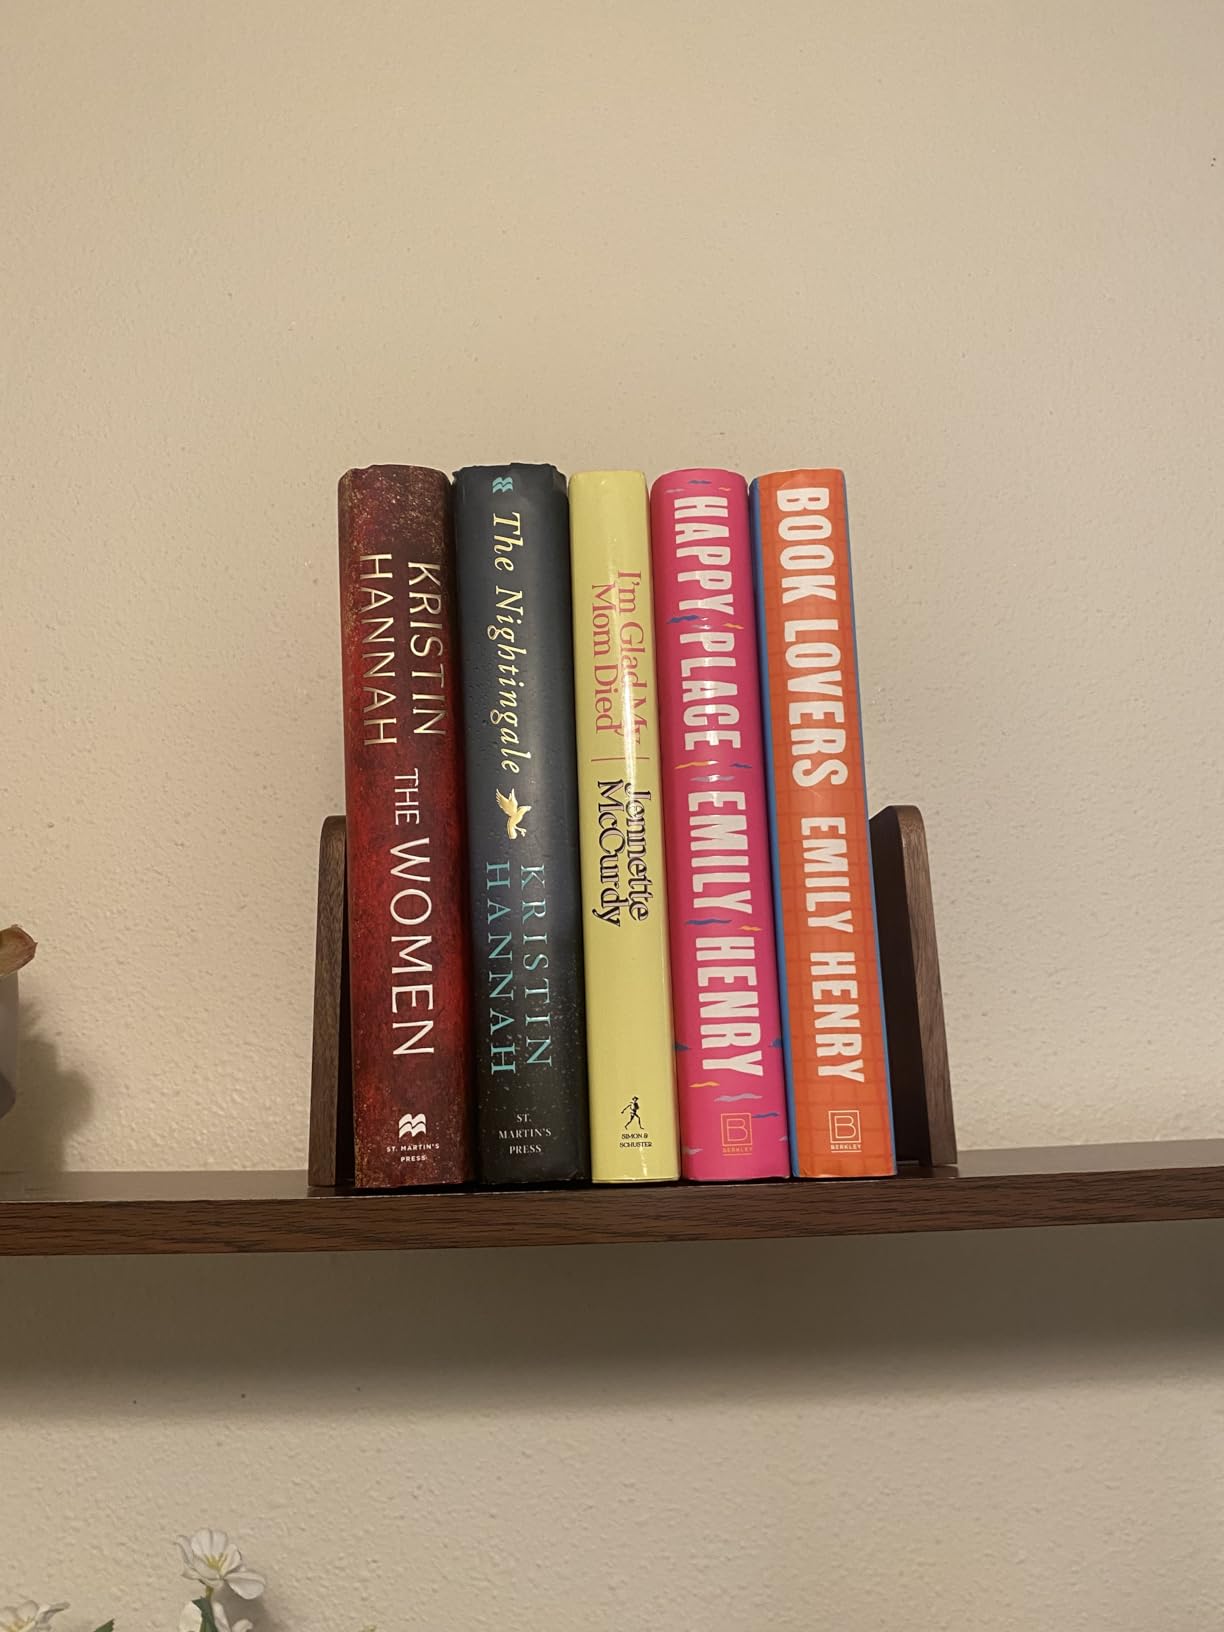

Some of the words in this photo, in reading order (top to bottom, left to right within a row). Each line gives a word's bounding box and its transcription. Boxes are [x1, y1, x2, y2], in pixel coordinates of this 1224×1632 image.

[492, 512, 523, 573] The
[617, 570, 642, 617] I'm
[672, 495, 735, 616] HAPPY
[776, 487, 837, 603] BOOK
[359, 553, 398, 746] HANNAH
[408, 562, 446, 737] KRISTIN
[488, 586, 533, 775] Nightingale
[591, 583, 617, 657] Mom
[619, 621, 648, 689] Glad
[593, 664, 622, 734] Died
[680, 629, 742, 751] PLACE
[783, 617, 849, 788] LOVERS
[394, 768, 420, 825] THE
[592, 779, 630, 928] McCurdy
[624, 782, 653, 922] Jennette
[687, 790, 754, 914] EMILY
[799, 817, 853, 933] EMILY
[390, 837, 434, 1057] WOMEN
[486, 862, 516, 1074] HANNAH
[520, 864, 552, 1067] KRISTIN
[695, 937, 764, 1077] HENRY
[808, 952, 866, 1083] HENRY
[400, 1142, 440, 1152] MARTIN'S
[498, 1128, 552, 1140] MARTIN'S
[509, 1144, 542, 1155] PRESS
[516, 1113, 532, 1123] ST.
[619, 1140, 652, 1148] SCHUSTER
